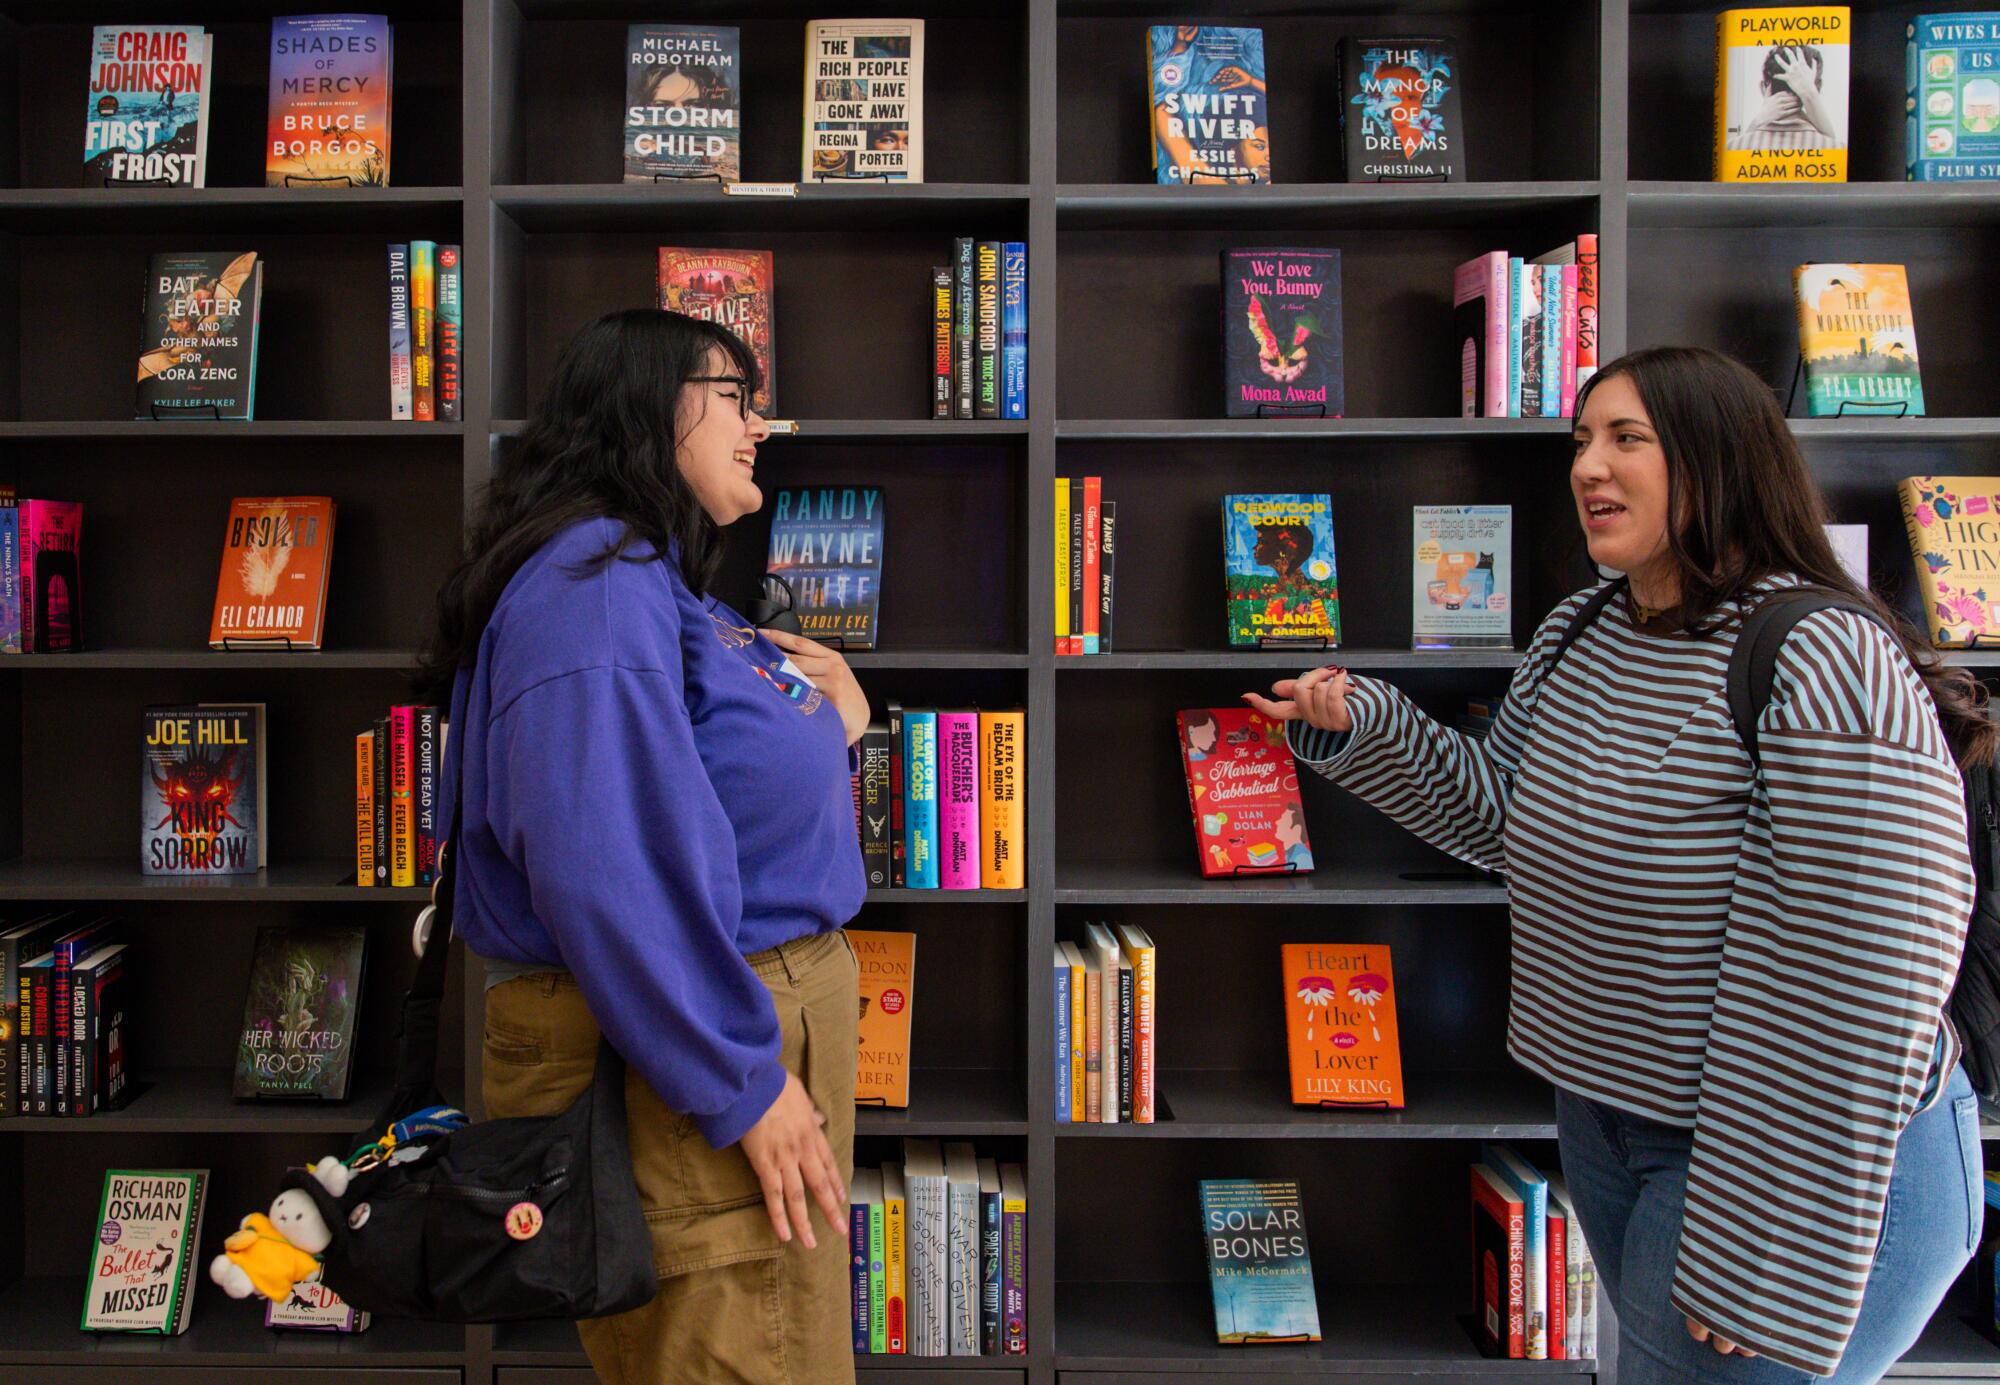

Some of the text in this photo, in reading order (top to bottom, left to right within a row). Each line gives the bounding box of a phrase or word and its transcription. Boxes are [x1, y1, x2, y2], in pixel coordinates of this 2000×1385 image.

[1741, 16, 1841, 32] PLAYWORLD
[1932, 25, 1985, 40] WIVES
[117, 32, 187, 62] CRAIG
[277, 37, 377, 55] SHADES
[642, 38, 722, 52] MICHAEL
[821, 40, 847, 55] THE
[315, 59, 335, 70] OF
[632, 53, 732, 66] ROBOTHAM
[1387, 50, 1418, 64] THE
[1972, 53, 1992, 67] US
[92, 63, 202, 92] JOHNSON
[820, 62, 908, 76] RICH PEOPLE
[282, 77, 369, 95] MERCY
[872, 83, 905, 97] HAVE
[1366, 79, 1442, 92] MANOR
[828, 104, 905, 118] GONE AWAY
[1165, 93, 1256, 114] SWIFT
[284, 115, 366, 130] BRUCE
[629, 106, 733, 127] STORM
[1391, 107, 1419, 121] OF
[86, 121, 161, 150] FIRST
[1168, 119, 1256, 139] RIVER
[273, 140, 376, 156] BORGOS
[634, 134, 726, 156] CHILD
[819, 134, 858, 147] REGINA
[1366, 137, 1447, 150] DREAMS
[859, 154, 903, 166] PORTER
[1189, 150, 1236, 163] ESSIE
[112, 153, 196, 183] FROST
[1364, 165, 1433, 175] CHRISTINA
[1737, 164, 1837, 178] ADAM ROSS
[1938, 165, 1974, 177] PLUM
[676, 258, 752, 274] DEANNA RAYBOURN
[979, 246, 996, 281] JOHN
[1252, 261, 1312, 276] We Love
[159, 276, 199, 293] BAT
[391, 253, 406, 329] DALE BROWN
[961, 244, 972, 335] Dog Day Afternoon
[1006, 258, 1025, 306] Silva
[1242, 279, 1323, 298] You, Bunny
[174, 300, 242, 316] EATER
[936, 288, 950, 319] JAMES
[1578, 253, 1597, 349] Deep Cuts
[1846, 292, 1869, 310] THE
[198, 322, 220, 331] AND
[980, 285, 996, 350] SANDFORD
[1817, 315, 1903, 332] MORNINGSIDE
[161, 337, 238, 347] OTHER NAMES
[936, 322, 950, 374] PATTERSON
[180, 354, 201, 362] FOR
[982, 356, 994, 380] TOXIC
[158, 368, 237, 380] CORA ZENG
[982, 382, 994, 403] PREY
[1242, 385, 1326, 401] Mona Awad
[776, 490, 878, 521] RANDY
[1234, 503, 1325, 513] REDWOOD
[1249, 516, 1312, 526] COURT
[40, 532, 74, 551] RETURN
[231, 516, 318, 547] BROILER
[774, 533, 874, 564] WAYNE
[1074, 538, 1081, 548] OF
[770, 575, 870, 609] WHITE
[220, 606, 304, 627] ELI CRANOR
[846, 616, 868, 628] EYE
[147, 719, 248, 745] JOE HILL
[421, 715, 432, 829] NOT QUITE DEAD YET
[878, 748, 888, 787] LIGHT
[912, 723, 923, 801] FERAL GODS
[952, 732, 960, 803] MASQUERADE
[962, 732, 973, 803] BUTCHER'S
[994, 723, 1003, 801] BEDLAM BRIDE
[1005, 724, 1013, 801] THE EYE OF THE
[1210, 761, 1276, 781] Marriage
[863, 748, 878, 805] BRINGER
[395, 716, 406, 870] CARL HIAASEN FEVER BEACH
[1210, 777, 1279, 802] Sabbatical
[172, 801, 225, 834] KING
[1239, 811, 1263, 819] LIAN
[1234, 821, 1272, 830] DOLAN
[151, 837, 248, 869] SORROW
[959, 841, 967, 861] MATT
[1307, 951, 1370, 970] Heart
[74, 986, 86, 1041] LOCKED DOOR
[1122, 975, 1130, 1049] SHALLOW WATERS
[1325, 1007, 1360, 1026] the
[245, 1031, 343, 1049] HER WICKED
[256, 1054, 324, 1073] ROOTS
[1315, 1050, 1378, 1070] Lover
[1306, 1078, 1392, 1093] LILY KING
[109, 1201, 182, 1221] OSMAN
[917, 1207, 943, 1221] THE
[1210, 1210, 1301, 1231] SOLAR
[892, 1220, 900, 1264] ANCILLARY
[912, 1220, 947, 1255] SONG
[949, 1226, 978, 1261] WAR
[1213, 1237, 1304, 1259] BONES
[100, 1249, 157, 1277] Bullet
[984, 1230, 998, 1313] SPACE ODDITY
[1216, 1266, 1307, 1277] Mike McCormack
[1510, 1219, 1524, 1306] CHINESE GROOVE
[125, 1274, 146, 1285] That
[101, 1283, 168, 1314] MISSED
[911, 1266, 946, 1349] ORPHANS
[950, 1280, 977, 1350] GIVENS
